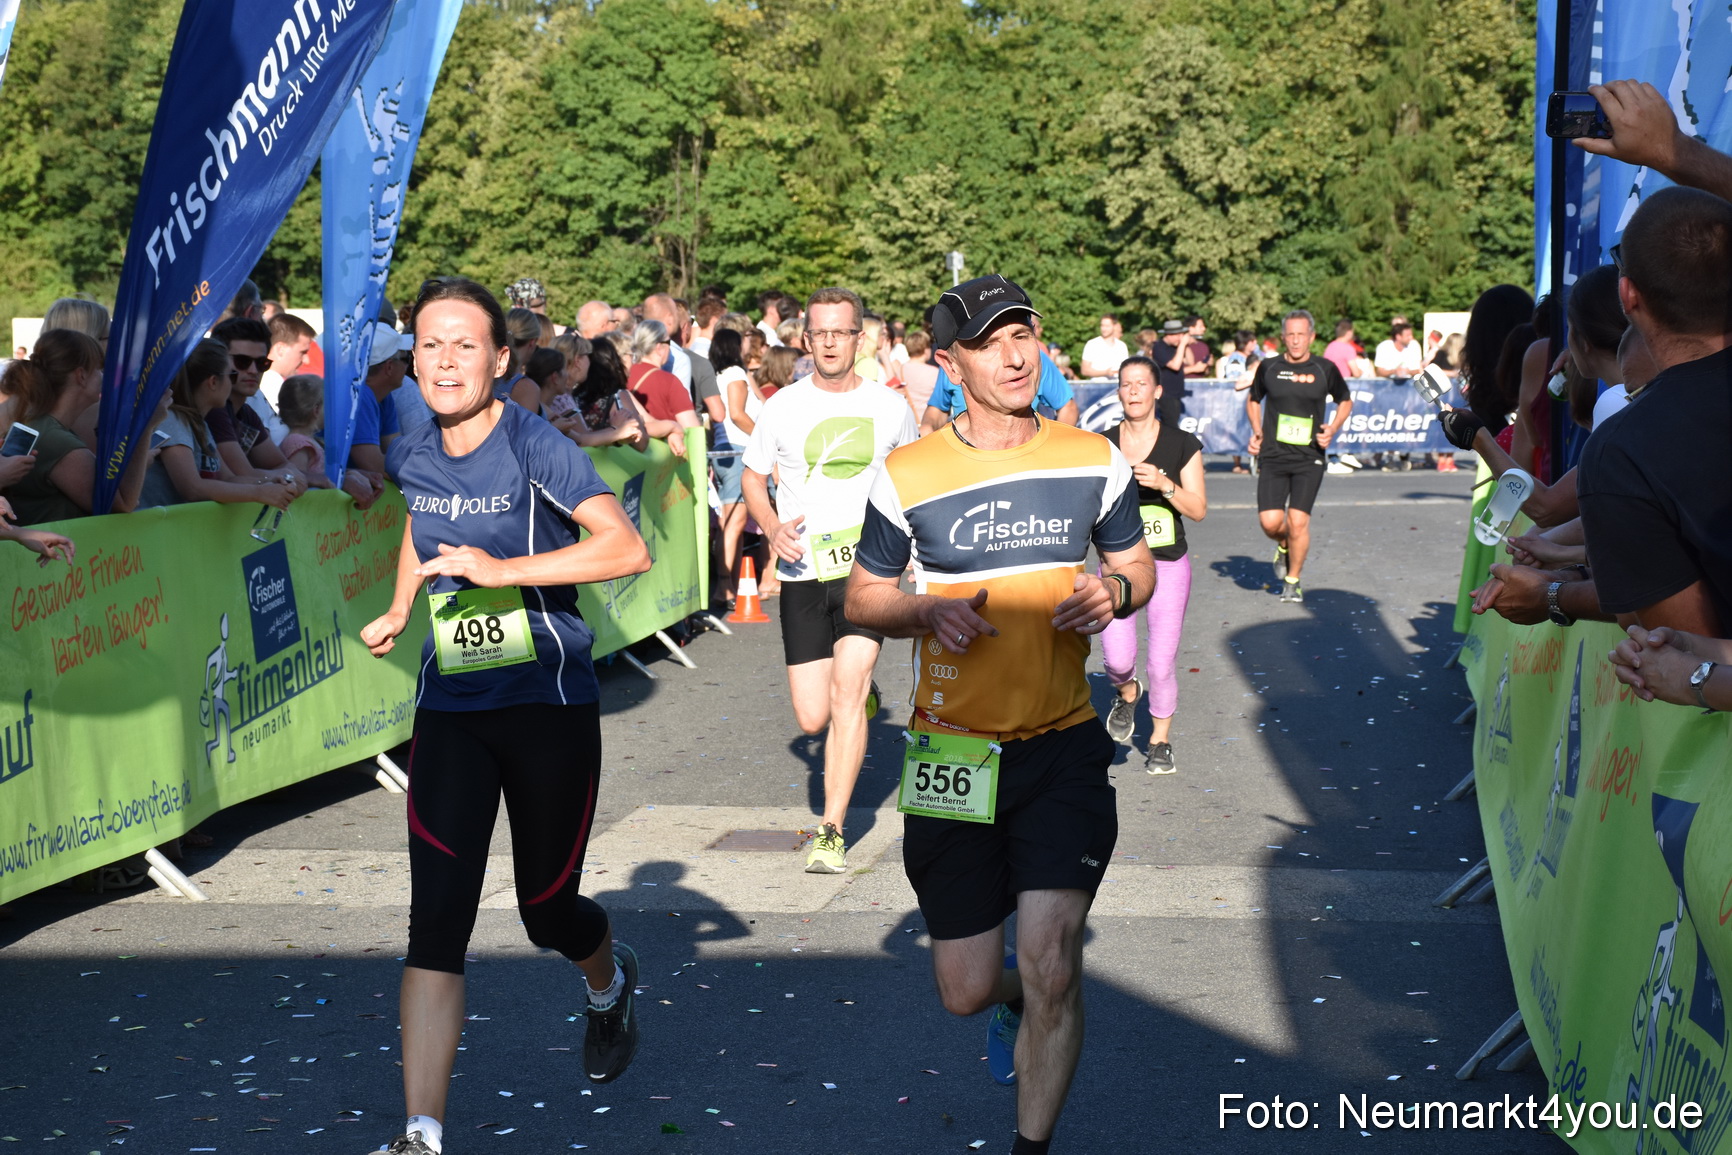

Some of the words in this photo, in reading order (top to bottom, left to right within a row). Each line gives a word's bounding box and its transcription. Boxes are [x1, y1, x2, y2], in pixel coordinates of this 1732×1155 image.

[258, 80, 304, 156] Druck
[300, 24, 330, 83] und
[1336, 432, 1428, 444] AUTOMOBILE
[973, 515, 1073, 543] Fischer
[984, 536, 1069, 553] AUTOMOBILE
[11, 564, 87, 633] Gesunde
[89, 545, 145, 594] Firmen
[255, 577, 286, 605] Fischer
[261, 595, 286, 615] AUTOMOBILE
[51, 614, 107, 677] laufen
[105, 576, 169, 650] länger!
[453, 616, 505, 649] 498
[461, 650, 479, 658] Weiß
[480, 646, 503, 656] Sarah
[462, 657, 486, 665] Europoles
[237, 610, 344, 725] firmenlauf
[242, 706, 293, 752] neumarkt
[914, 762, 972, 797] 556
[909, 800, 925, 808] Fischer
[925, 803, 957, 812] Automobile
[916, 793, 940, 803] Seifert
[942, 796, 967, 806] Bernd
